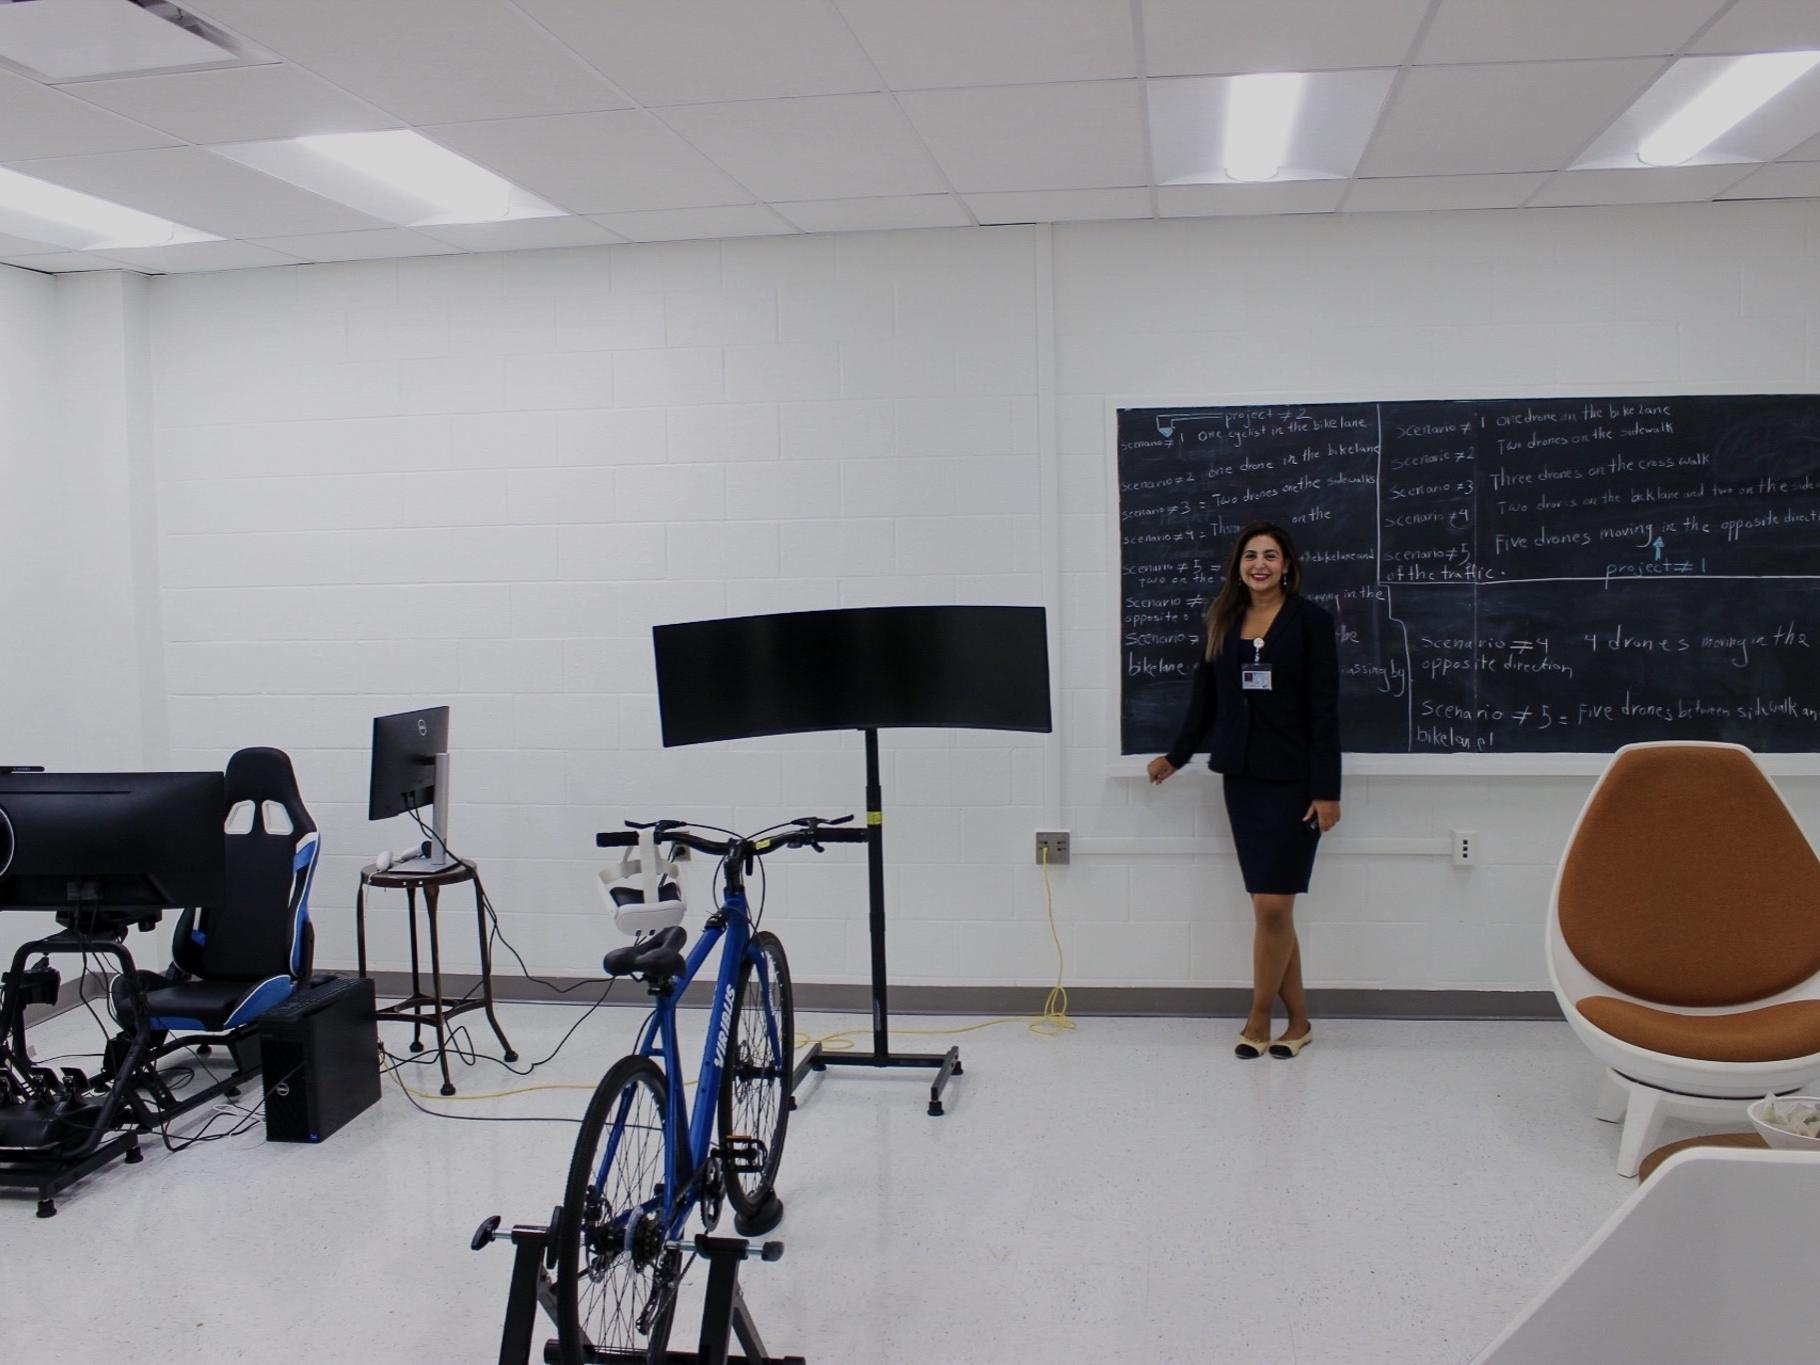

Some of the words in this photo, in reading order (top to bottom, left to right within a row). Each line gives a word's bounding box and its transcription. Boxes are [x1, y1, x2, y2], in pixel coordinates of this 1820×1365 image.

[1225, 409, 1272, 429] project
[1524, 407, 1557, 423] drone
[1583, 403, 1603, 421] the
[1227, 424, 1266, 448] cyclist
[1287, 421, 1308, 433] the
[1498, 439, 1522, 455] Two
[1528, 432, 1569, 449] drones
[1592, 426, 1613, 440] the
[1121, 477, 1173, 492] scenario
[1240, 455, 1274, 471] drone
[1283, 454, 1298, 466] in
[1303, 446, 1320, 462] the
[1489, 465, 1533, 491] Three
[1538, 464, 1583, 481] drones
[1608, 452, 1634, 473] the
[1211, 493, 1238, 507] Two
[1243, 488, 1279, 502] drones
[1297, 474, 1321, 490] the
[1497, 500, 1529, 515] Two
[1601, 489, 1621, 506] the
[1682, 482, 1705, 499] and
[1711, 483, 1733, 497] two
[1755, 475, 1789, 494] the
[1122, 533, 1172, 545] scenario
[1291, 515, 1307, 524] on
[1308, 505, 1332, 521] the
[1495, 533, 1528, 555] Five
[1534, 526, 1592, 546] drones
[1600, 523, 1653, 548] moving
[1662, 521, 1678, 533] in
[1683, 515, 1711, 534] the
[1720, 509, 1780, 542] opposite
[1171, 576, 1188, 584] on
[1192, 572, 1214, 584] the
[1386, 563, 1405, 581] of
[1407, 563, 1436, 581] the
[1604, 557, 1673, 590] project
[1359, 585, 1386, 600] the
[1125, 610, 1179, 628] opposite
[1584, 633, 1598, 653] 4
[1608, 623, 1691, 652] drones
[1701, 636, 1750, 668] moving
[1773, 619, 1811, 648] the
[1391, 659, 1405, 698] by
[1421, 653, 1496, 680] opposite
[1503, 652, 1574, 679] direction
[1578, 703, 1614, 726] Five
[1621, 689, 1674, 722] drones
[1678, 698, 1731, 720] between
[1801, 706, 1820, 721] an
[713, 983, 736, 1069] VIRIBUS
